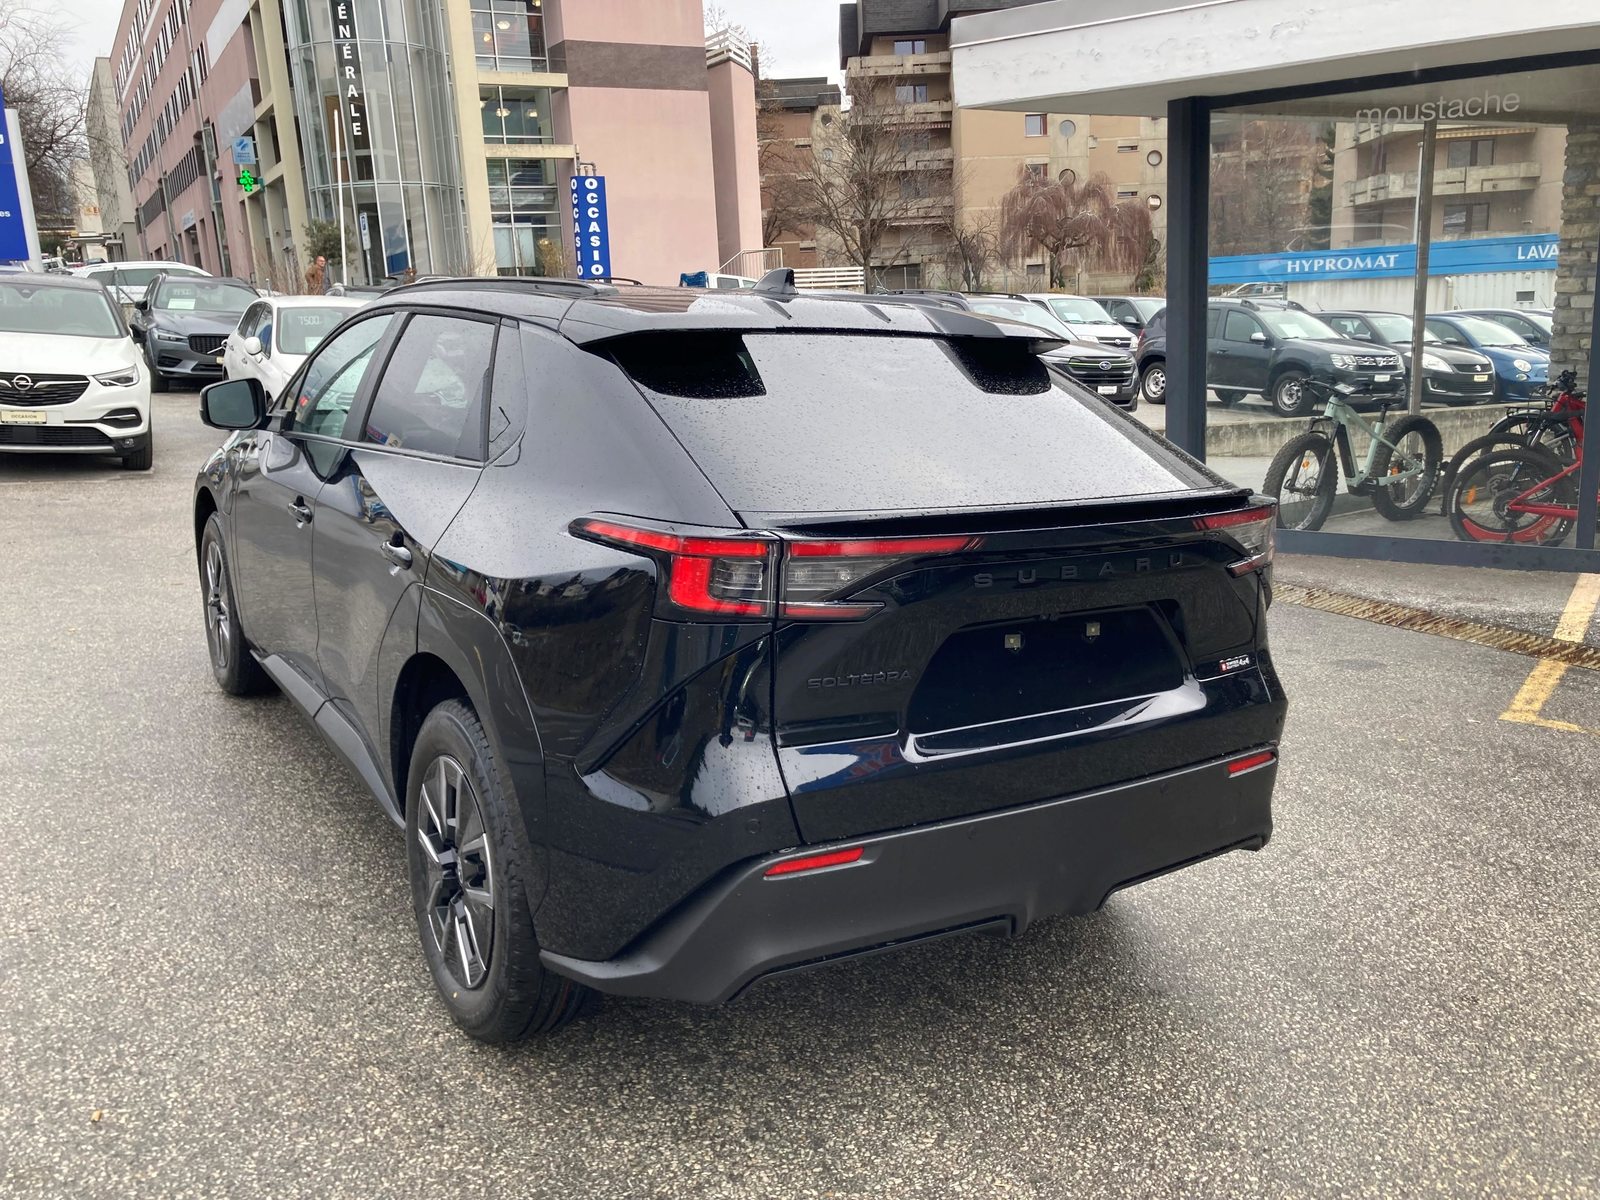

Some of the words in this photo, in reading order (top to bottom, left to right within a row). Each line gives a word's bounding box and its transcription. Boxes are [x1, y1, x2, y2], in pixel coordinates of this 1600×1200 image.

[1355, 89, 1520, 138] moustache
[585, 178, 604, 282] OCCASIO
[1287, 254, 1399, 273] HYPROMAT
[974, 552, 1183, 588] SUBARU
[807, 670, 913, 689] SOLTERRA
